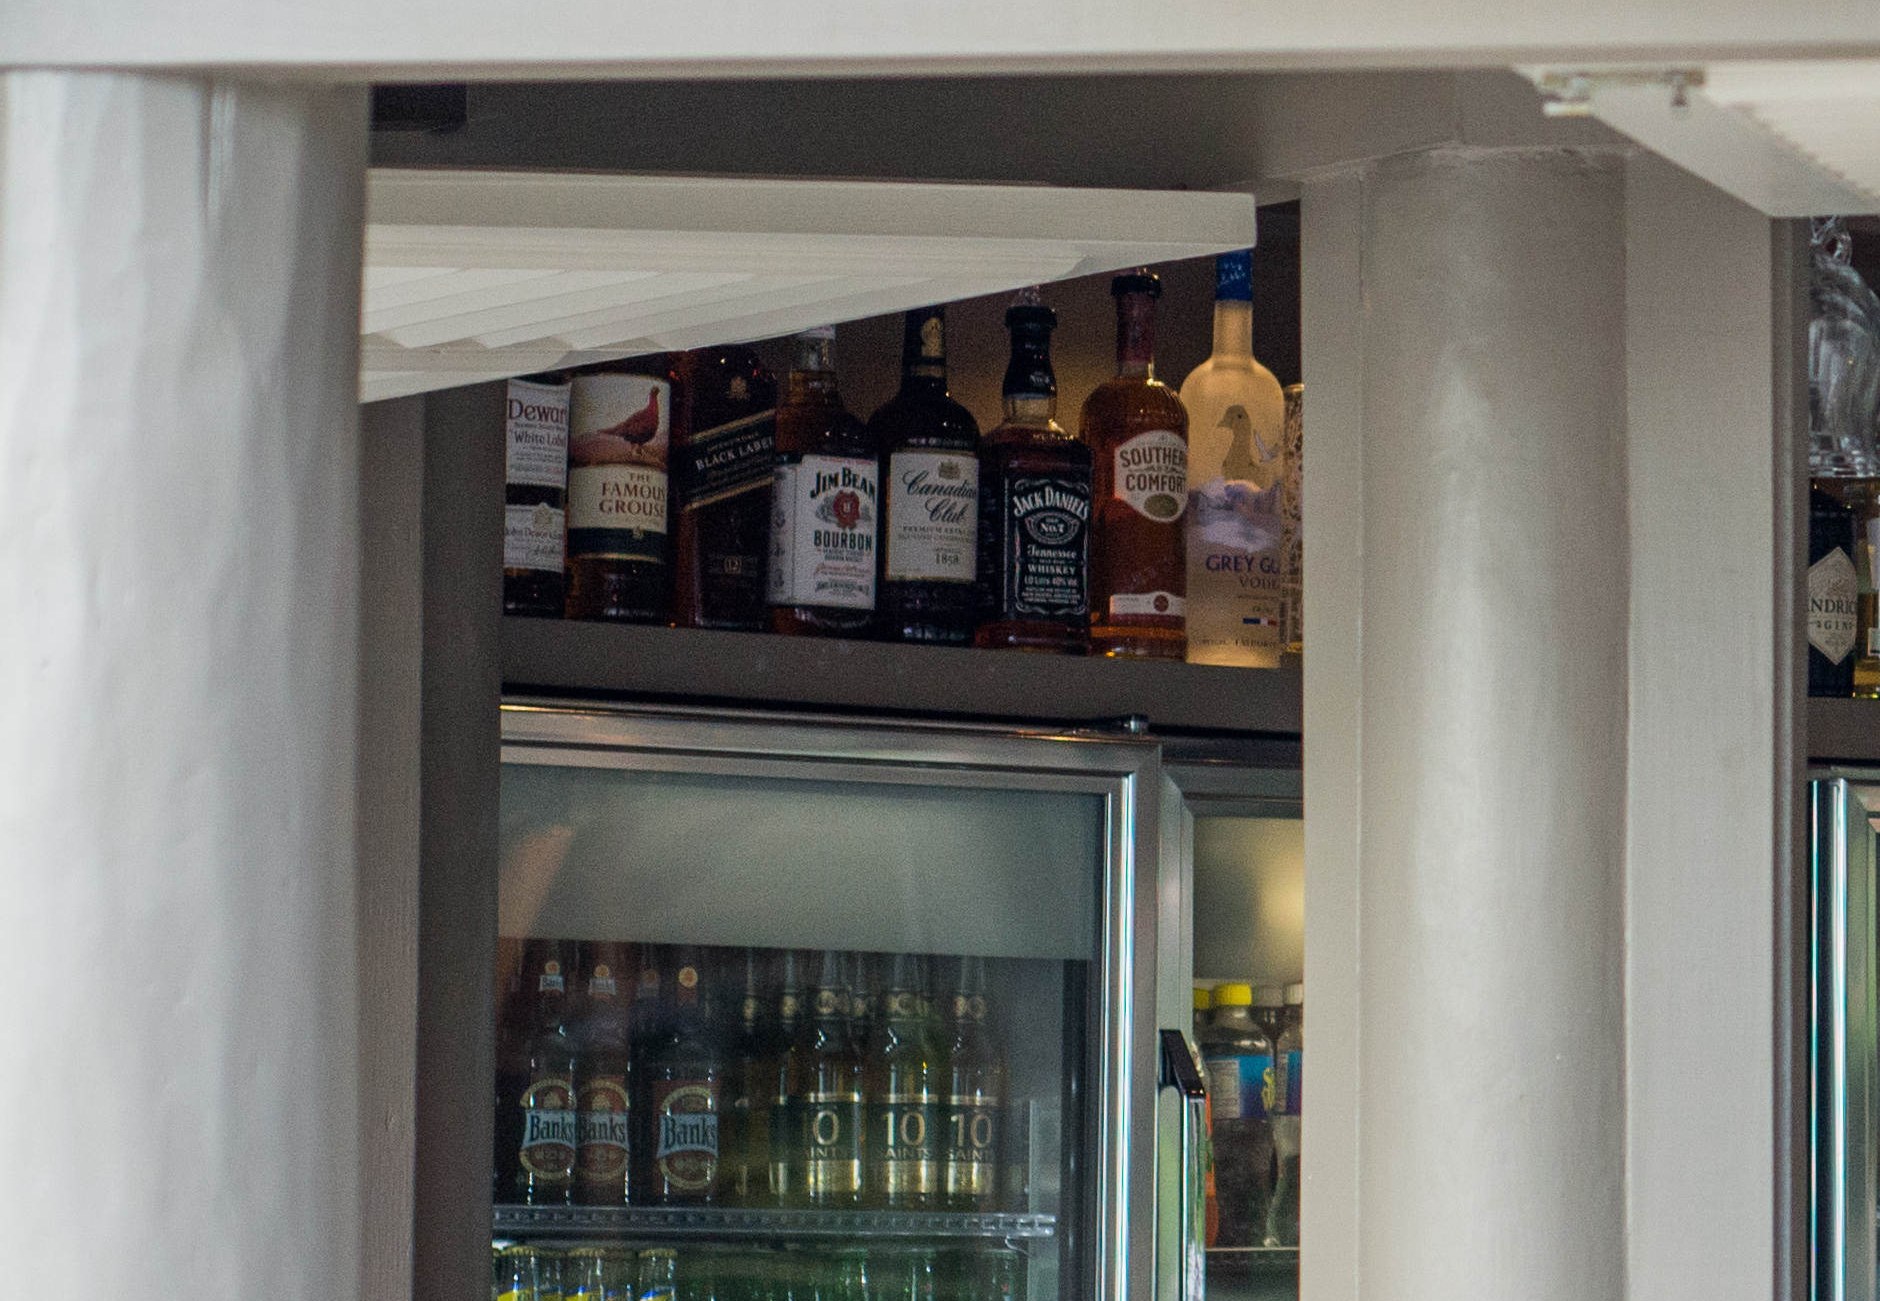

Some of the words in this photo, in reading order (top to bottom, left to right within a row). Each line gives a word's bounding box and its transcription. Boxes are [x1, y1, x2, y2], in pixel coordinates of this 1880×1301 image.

[696, 450, 736, 471] BLACK
[630, 472, 651, 483] THE
[810, 471, 839, 499] JIM
[924, 498, 970, 525] Club
[1012, 490, 1045, 517] JACK
[814, 529, 872, 551] BOURBON
[1027, 543, 1077, 559] Tennessee
[1027, 563, 1076, 576] WHISKEY
[1205, 554, 1255, 574] GREY
[529, 1114, 577, 1142] Banks
[578, 1115, 626, 1143] Banks
[664, 1114, 718, 1148] Banks
[881, 1110, 927, 1147] 10
[951, 1111, 993, 1149] 10
